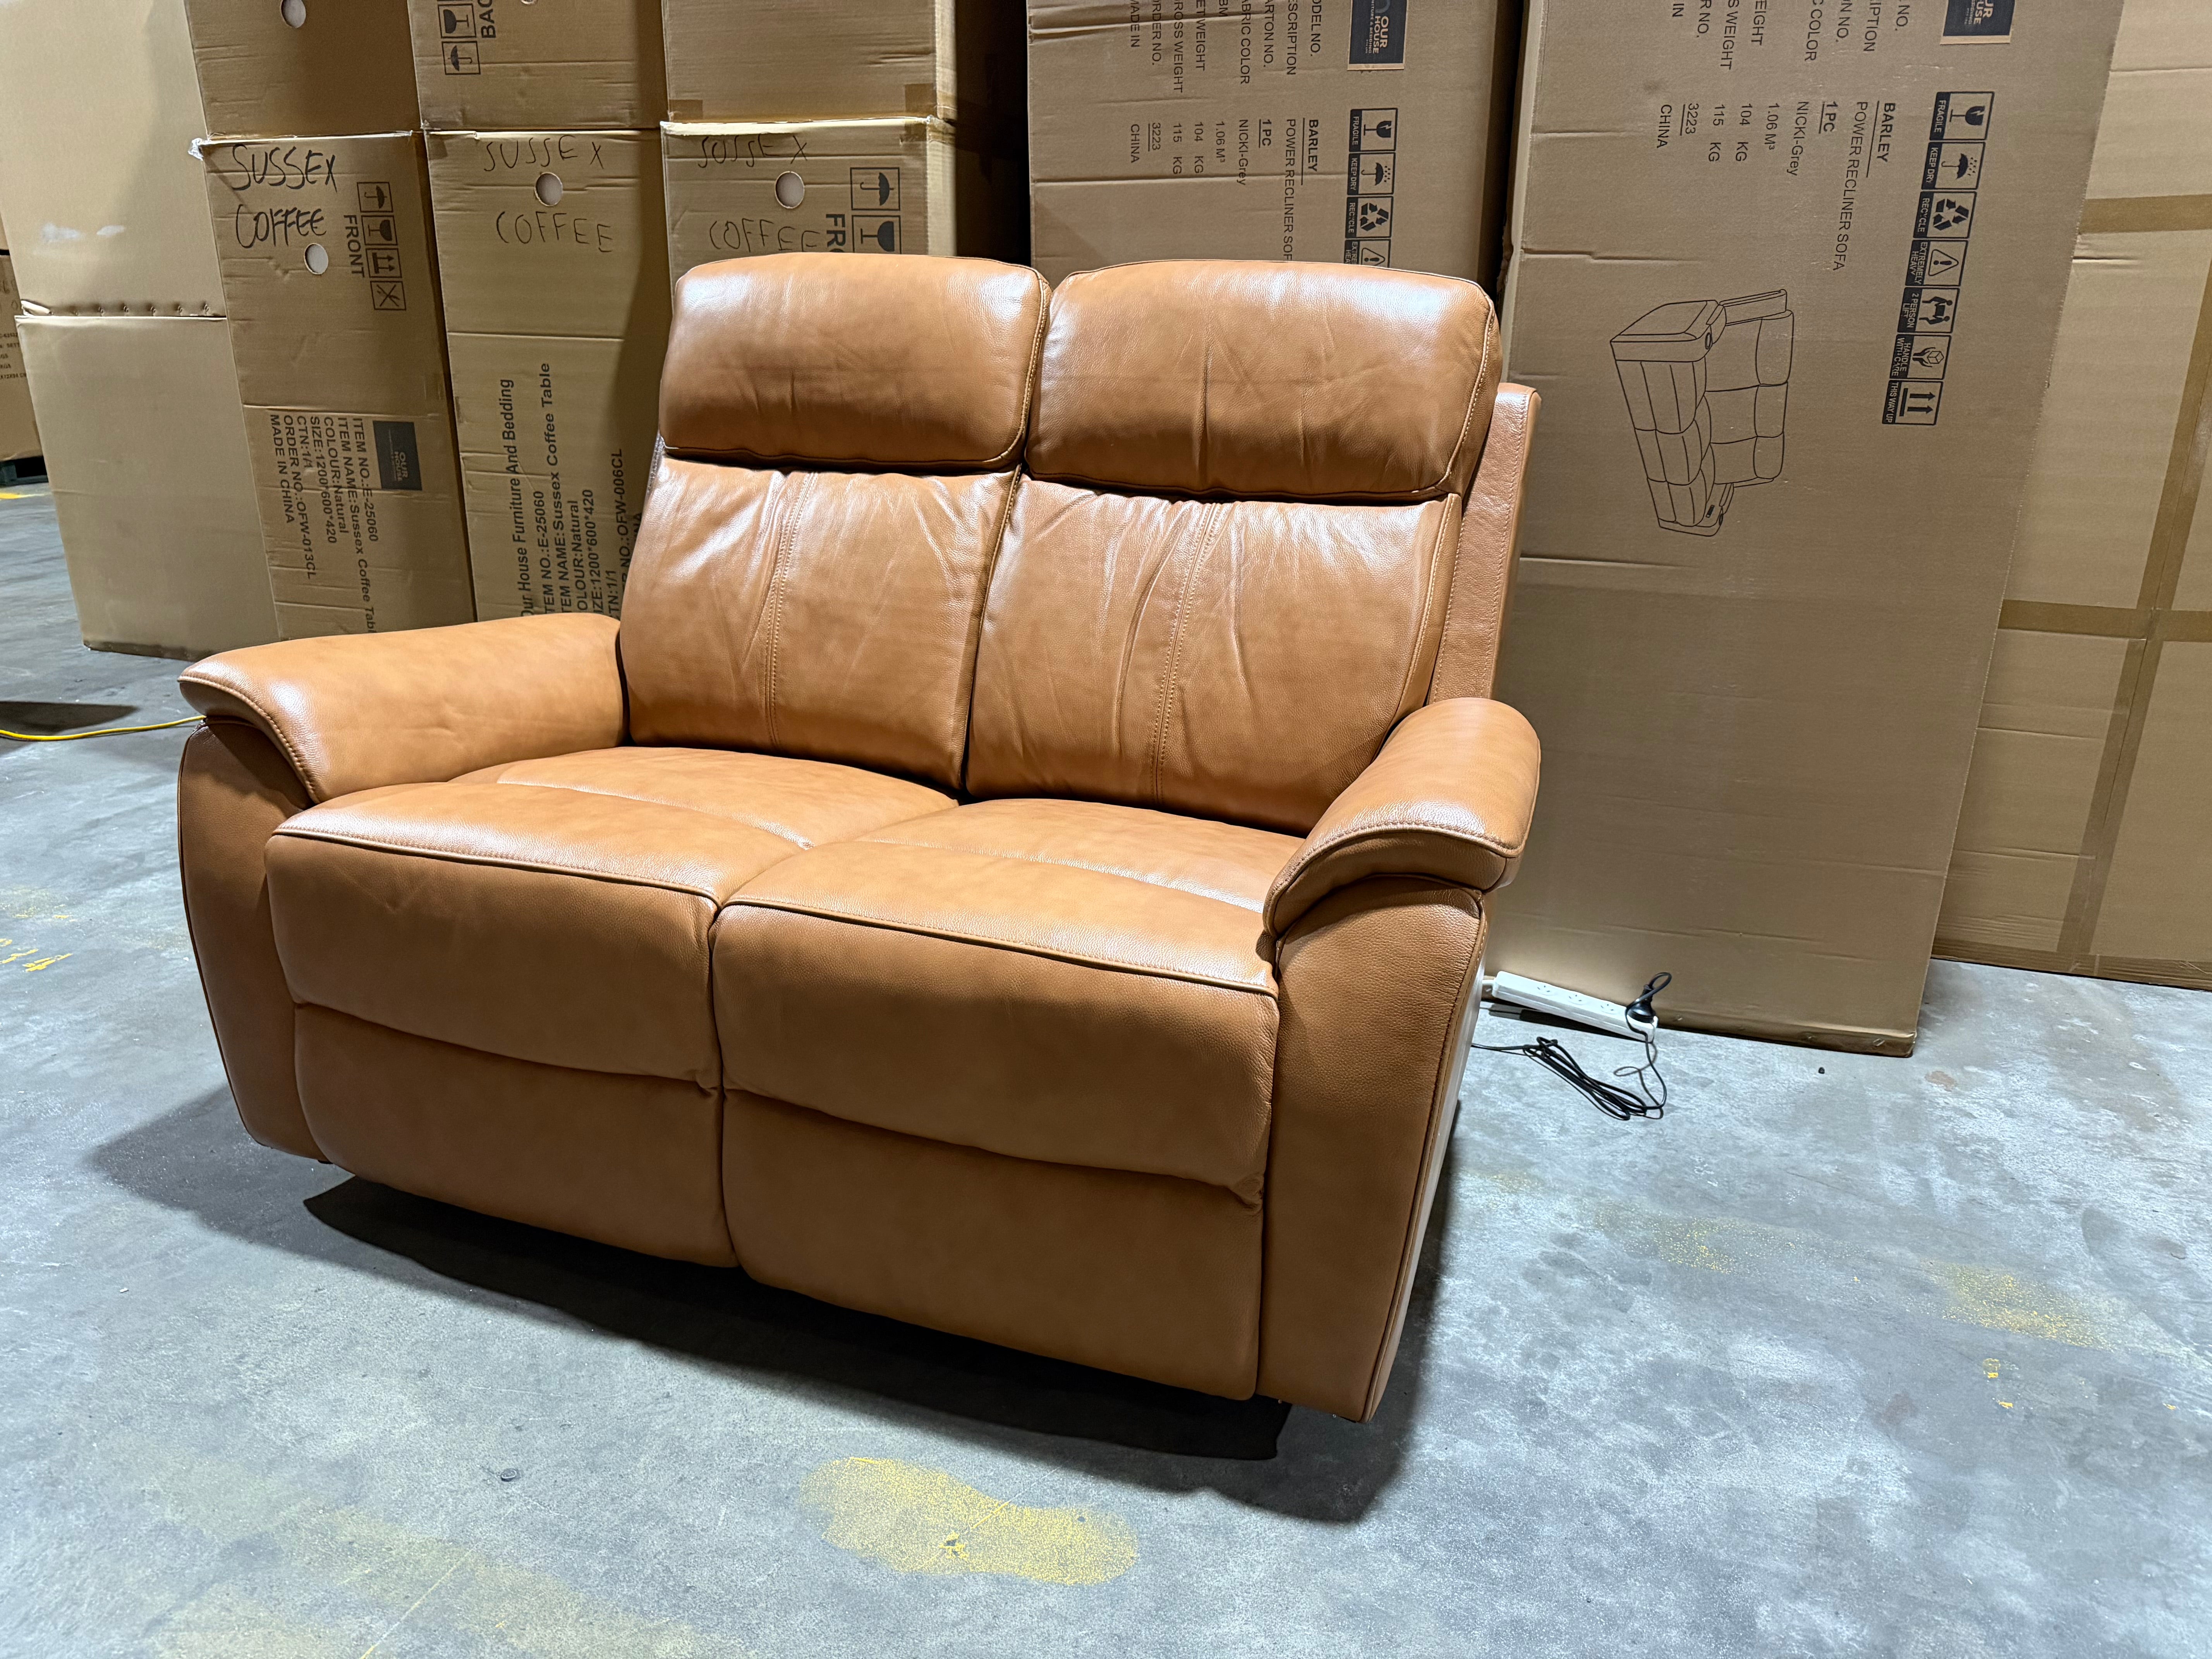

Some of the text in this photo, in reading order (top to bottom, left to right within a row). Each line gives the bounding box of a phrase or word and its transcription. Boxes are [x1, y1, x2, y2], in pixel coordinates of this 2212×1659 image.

[1672, 3, 1684, 18] IN
[1696, 13, 1711, 38] NO.
[1751, 0, 1767, 46] EIGHT
[1836, 17, 1851, 43] NO.
[1863, 0, 1882, 52] IPTION
[1894, 4, 1910, 31] NO.
[1973, 0, 1984, 25] USE
[1983, 0, 1994, 18] UR
[1130, 35, 1140, 48] IN
[1152, 0, 1161, 65] RDER NO.
[1173, 0, 1183, 93] ROSS WEIGHT
[1195, 18, 1206, 71] WEIGHT
[1310, 33, 1321, 57] NO.
[1373, 15, 1381, 54] HOUSE
[1379, 16, 1389, 48] OUR
[1720, 11, 1738, 70] WEIGHT
[1804, 9, 1822, 62] COLOR
[1240, 38, 1251, 84] COLOR
[1263, 45, 1274, 68] NO.
[1152, 122, 1161, 150] 3223
[1215, 121, 1225, 145] 1.06
[1262, 128, 1271, 146] PC
[1352, 116, 1360, 145] FRAGILE
[1656, 104, 1672, 149] CHINA
[1685, 103, 1699, 135] 3223
[1708, 104, 1726, 163] 115 KG
[1735, 103, 1753, 162] 104 KG
[1765, 103, 1780, 131] 1.06
[1786, 101, 1810, 176] NICKI-Grey
[1823, 112, 1837, 133] PC
[1876, 102, 1896, 163] BARLEY
[1934, 100, 1946, 133] FRAGILE
[484, 135, 604, 171] SUSSEX
[1130, 124, 1140, 163] CHINA
[1173, 123, 1182, 175] 115 KG
[1194, 122, 1204, 174] 104 KG
[1237, 119, 1249, 185] NICKI-Grey
[1308, 119, 1319, 172] BARLEY
[1925, 147, 1939, 183] KEEP DRY
[232, 143, 338, 193] SUSSEX
[1283, 118, 1296, 261] POWER RECLINER SOF
[1832, 101, 1869, 271] POWER RECLINER SOFA
[236, 204, 326, 248] COFFEE
[496, 211, 613, 252] COFFEE
[826, 214, 846, 252] FR
[1917, 198, 1930, 233] RECYCLE
[343, 215, 365, 278] FRONT
[1909, 251, 1919, 275] HEAVY
[1914, 241, 1928, 285] EXTREMELY
[1901, 303, 1910, 318] LIFT
[1907, 298, 1919, 328] PERSON
[1891, 337, 1905, 377] WITH CARE
[1899, 342, 1911, 372] HANDLE
[499, 379, 515, 441] Bedding
[1886, 382, 1899, 423] THIS WAY UP
[283, 415, 299, 467] ORDER
[338, 417, 351, 452] ITEM
[270, 414, 295, 524] MADE IN CHINA
[324, 417, 349, 533] COLOUR:Natural
[353, 418, 379, 542] ITEM NO.:E-25060
[399, 452, 408, 478] OUR
[503, 445, 519, 474] And
[343, 457, 364, 555] NAME:Sussex
[539, 363, 572, 613] TEM NAME:Sussex Coffee Table
[510, 478, 526, 543] Furniture
[517, 548, 531, 592] House
[533, 491, 555, 614] TEM NO.:E-25060
[567, 500, 588, 611] OLOUR:Natural
[582, 489, 604, 615] IZE:1200600420
[358, 558, 371, 602] Coffee
[605, 570, 620, 621] TN:1/1
